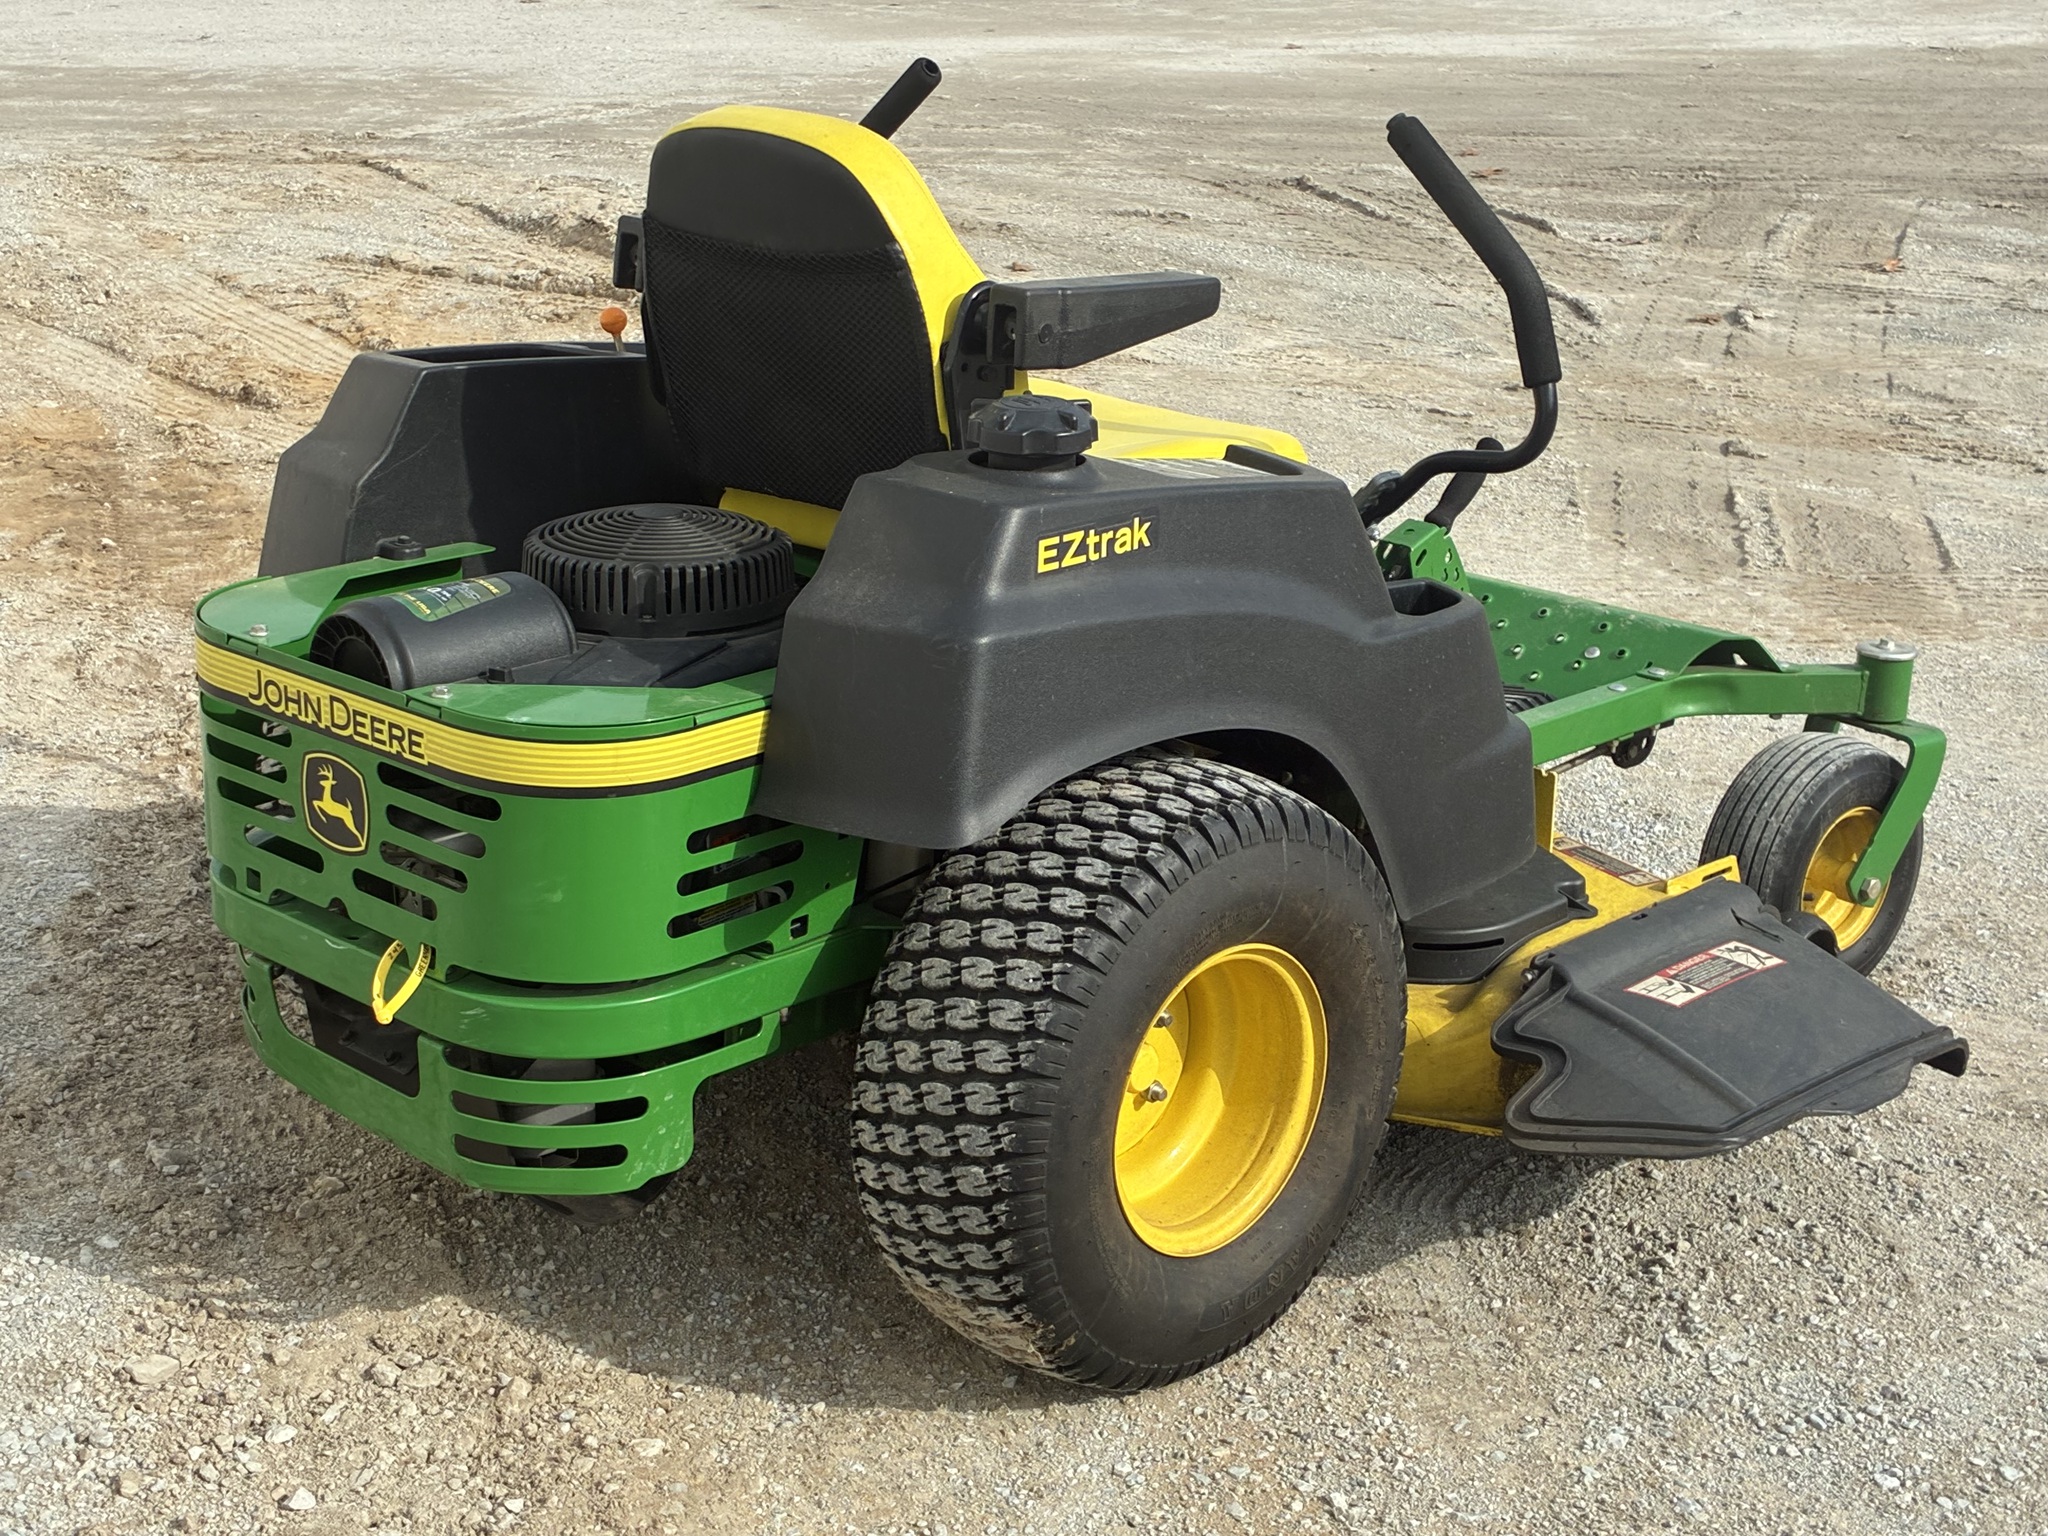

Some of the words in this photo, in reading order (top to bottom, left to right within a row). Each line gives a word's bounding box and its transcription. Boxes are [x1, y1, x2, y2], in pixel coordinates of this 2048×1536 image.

[1037, 516, 1152, 573] EZtrak
[248, 669, 323, 727] JOHN
[328, 694, 427, 763] DEERE
